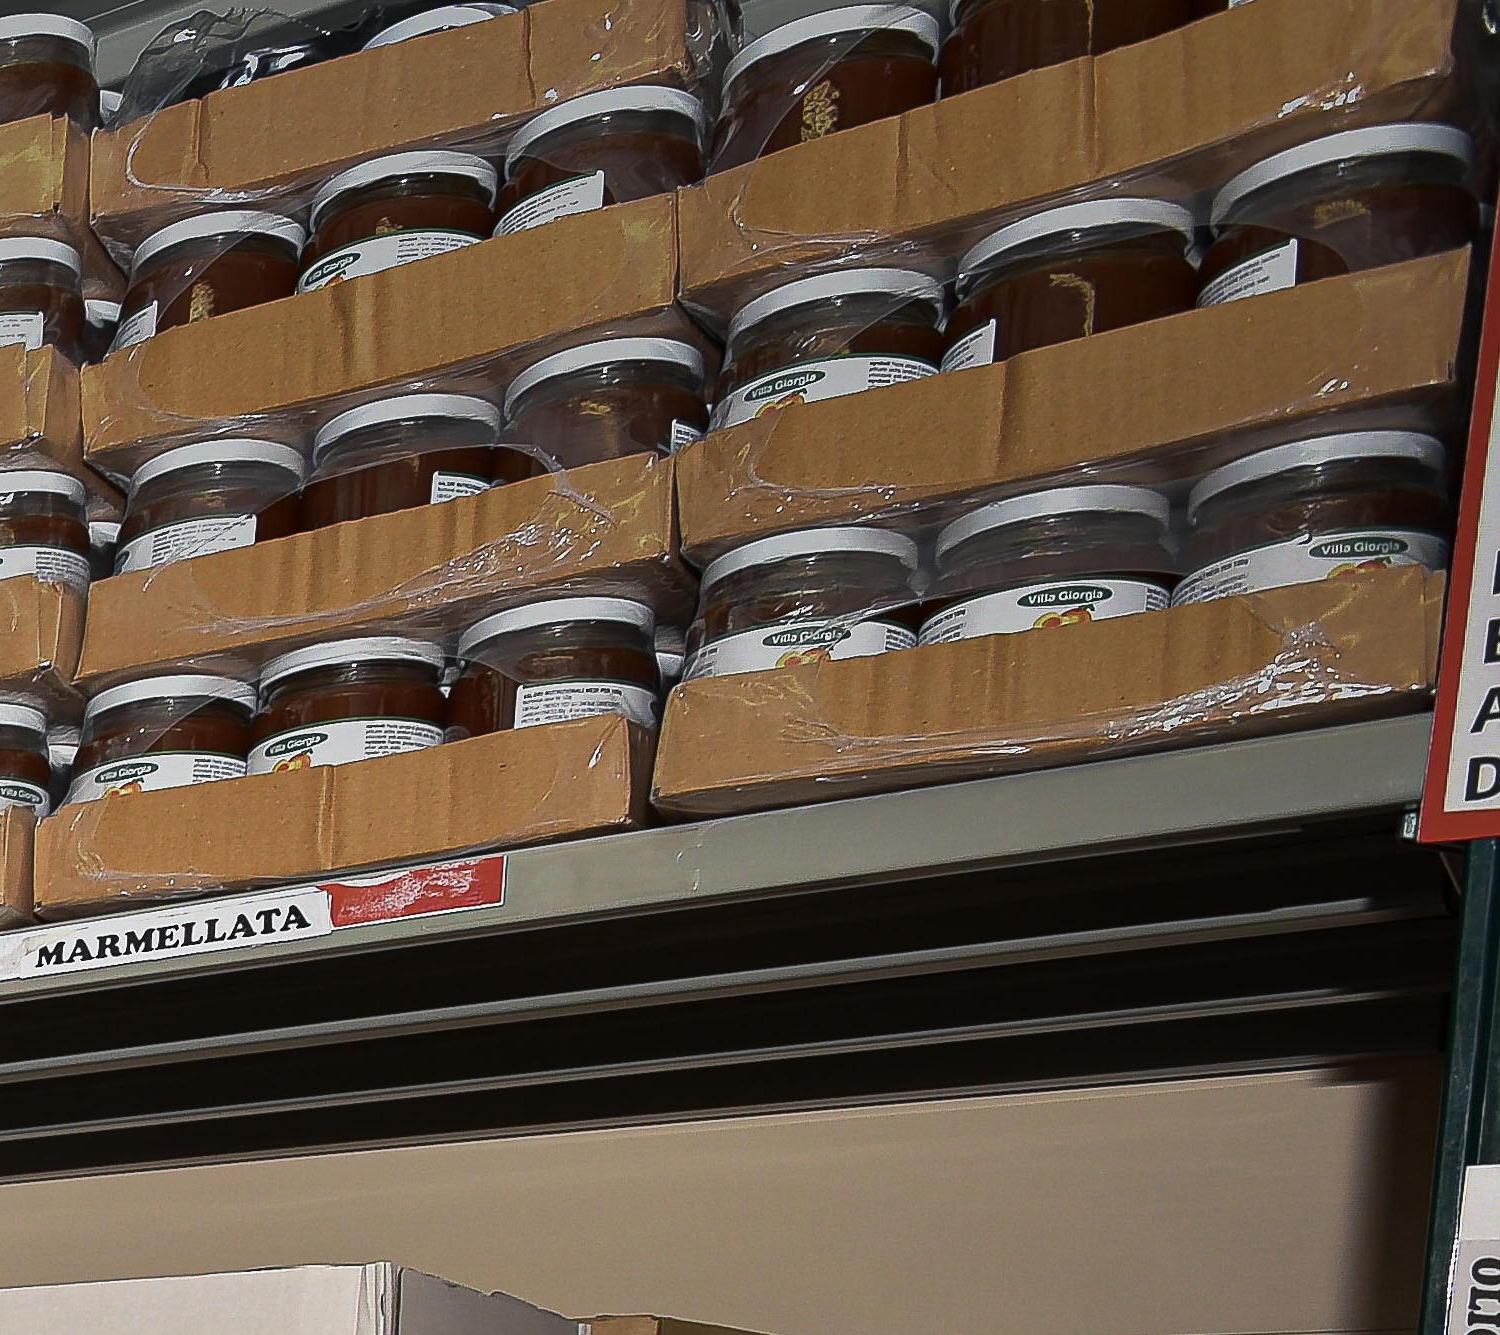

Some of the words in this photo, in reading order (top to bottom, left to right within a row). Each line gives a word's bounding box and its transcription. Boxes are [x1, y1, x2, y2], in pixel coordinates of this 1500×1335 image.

[1321, 544, 1351, 555] Villa
[1354, 542, 1400, 556] Giorgia
[1028, 594, 1056, 604] Villa
[1058, 590, 1104, 602] Giorgia
[35, 904, 311, 968] MARMELLATA
